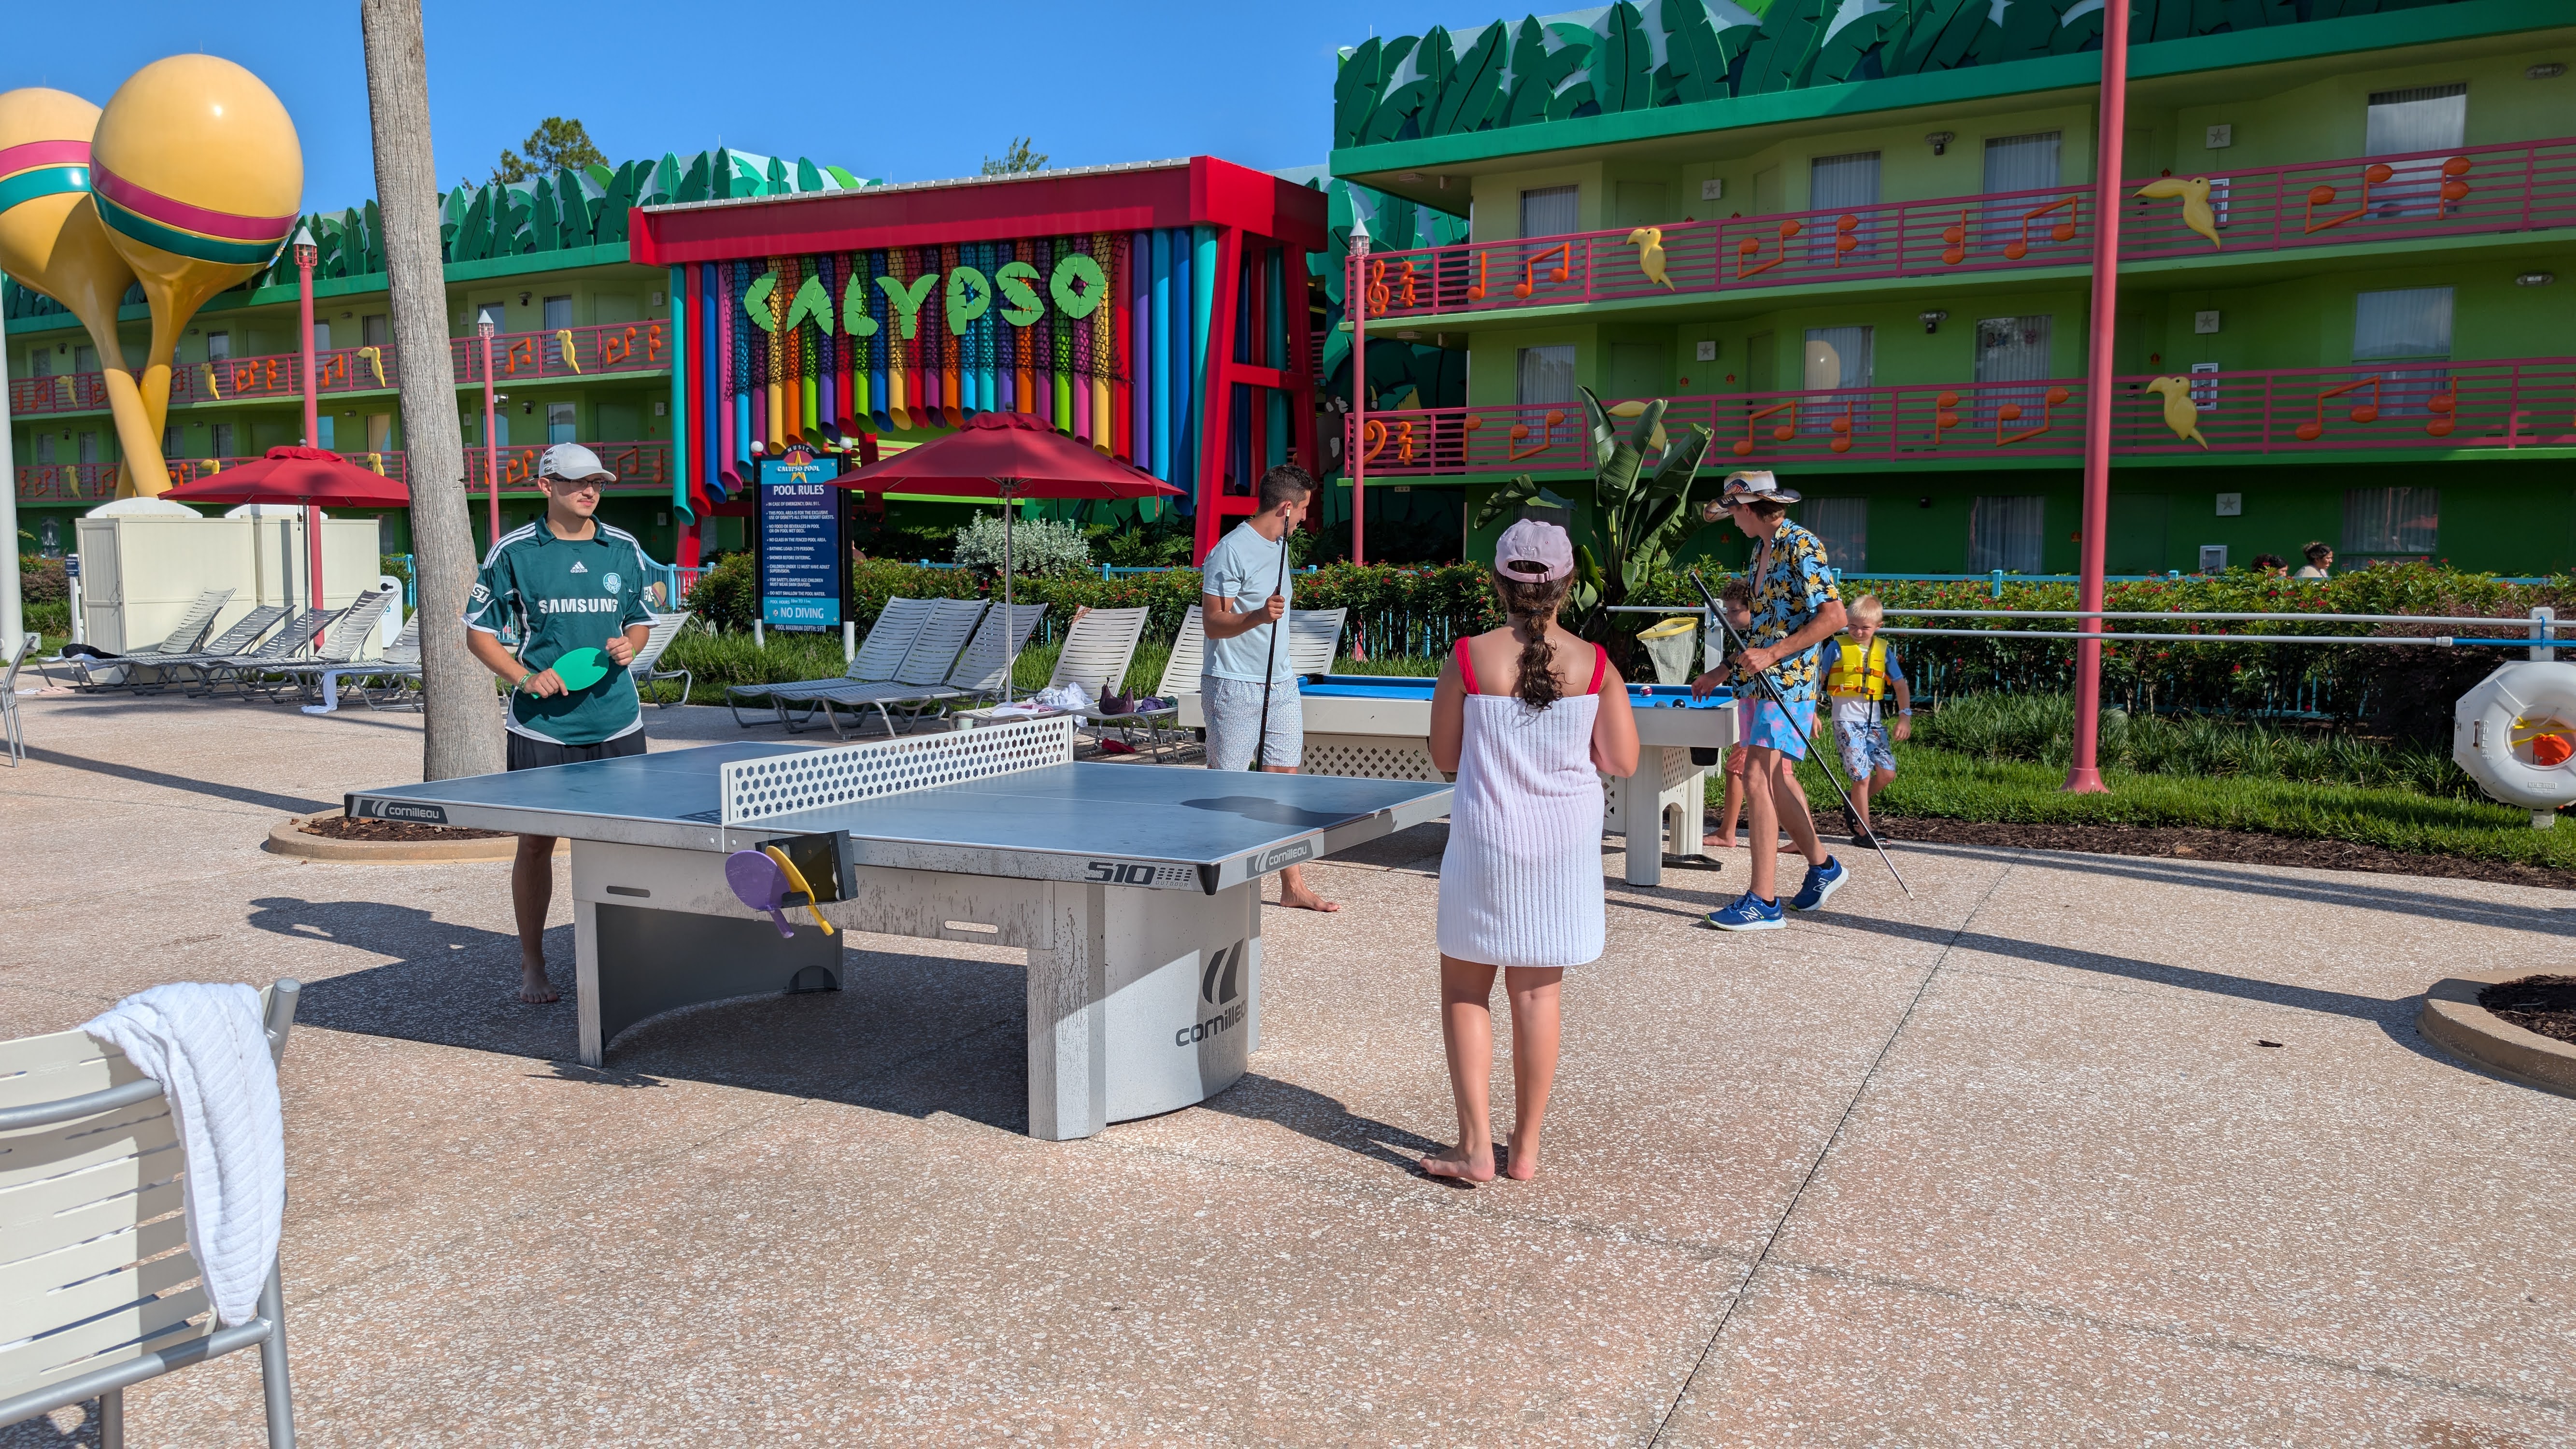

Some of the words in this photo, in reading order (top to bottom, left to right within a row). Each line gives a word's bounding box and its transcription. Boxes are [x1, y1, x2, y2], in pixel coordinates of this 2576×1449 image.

[744, 253, 1106, 340] CALYPSO
[787, 445, 810, 453] MUSIC
[774, 485, 797, 495] POOL
[798, 484, 824, 495] RULES
[539, 598, 618, 614] SAMSUNG
[781, 607, 793, 618] NO
[796, 608, 824, 619] DIVING
[389, 807, 439, 819] cornilleau
[1269, 845, 1307, 866] cornilleau
[1084, 862, 1156, 885] 510
[1176, 997, 1248, 1047] cornillea
